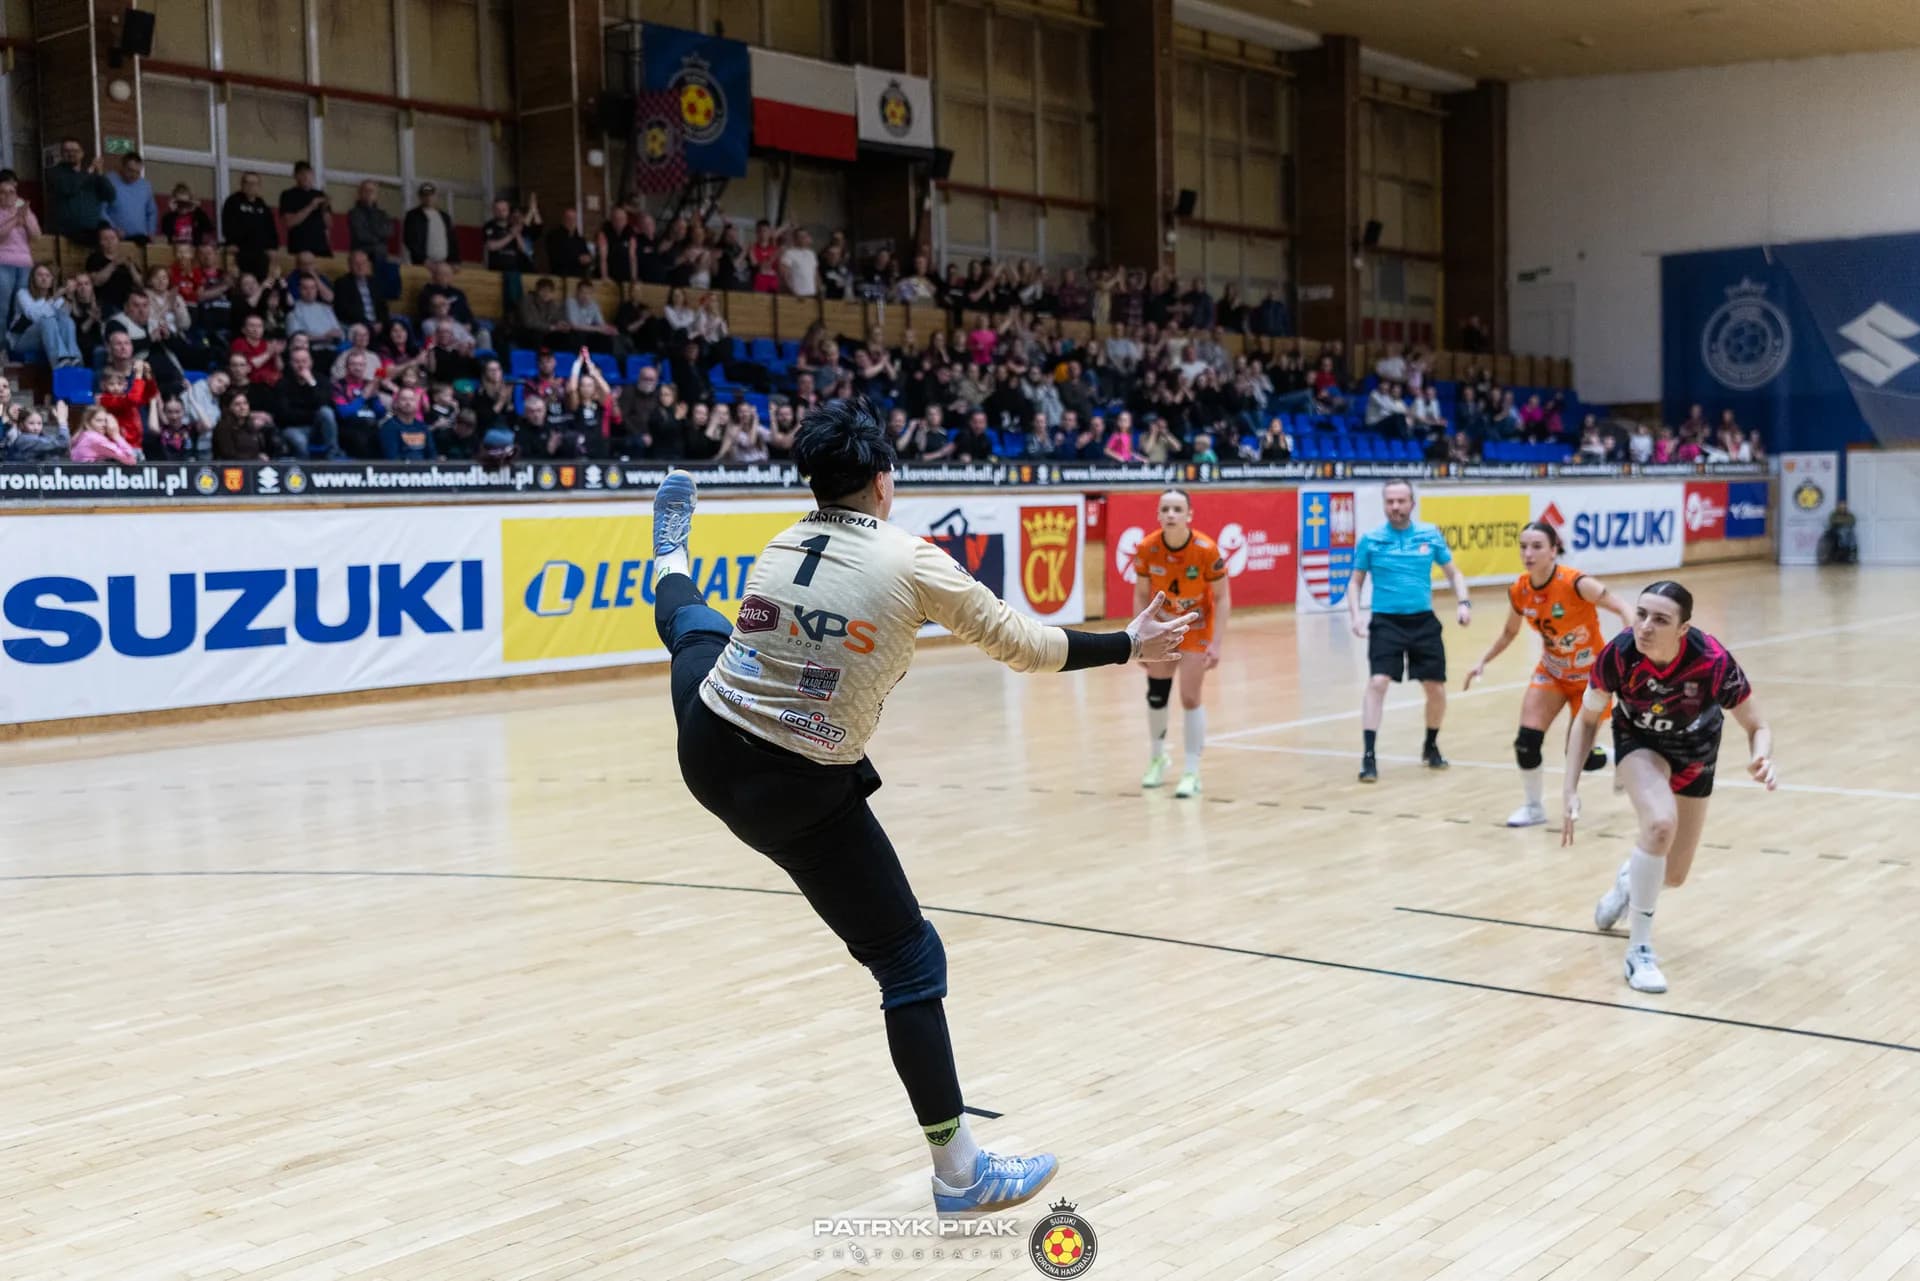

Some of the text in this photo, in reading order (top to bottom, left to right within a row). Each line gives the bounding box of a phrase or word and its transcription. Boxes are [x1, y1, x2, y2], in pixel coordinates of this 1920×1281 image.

[311, 466, 534, 490] www.koronahandball.pl
[1573, 510, 1675, 550] SUZUKI
[792, 534, 831, 587] 1
[1024, 550, 1068, 604] CK
[1168, 579, 1180, 596] 4
[2, 560, 484, 664] SUZUKI
[790, 604, 878, 654] KPS
[787, 638, 823, 651] FOOD
[784, 713, 842, 739] GOLIAT
